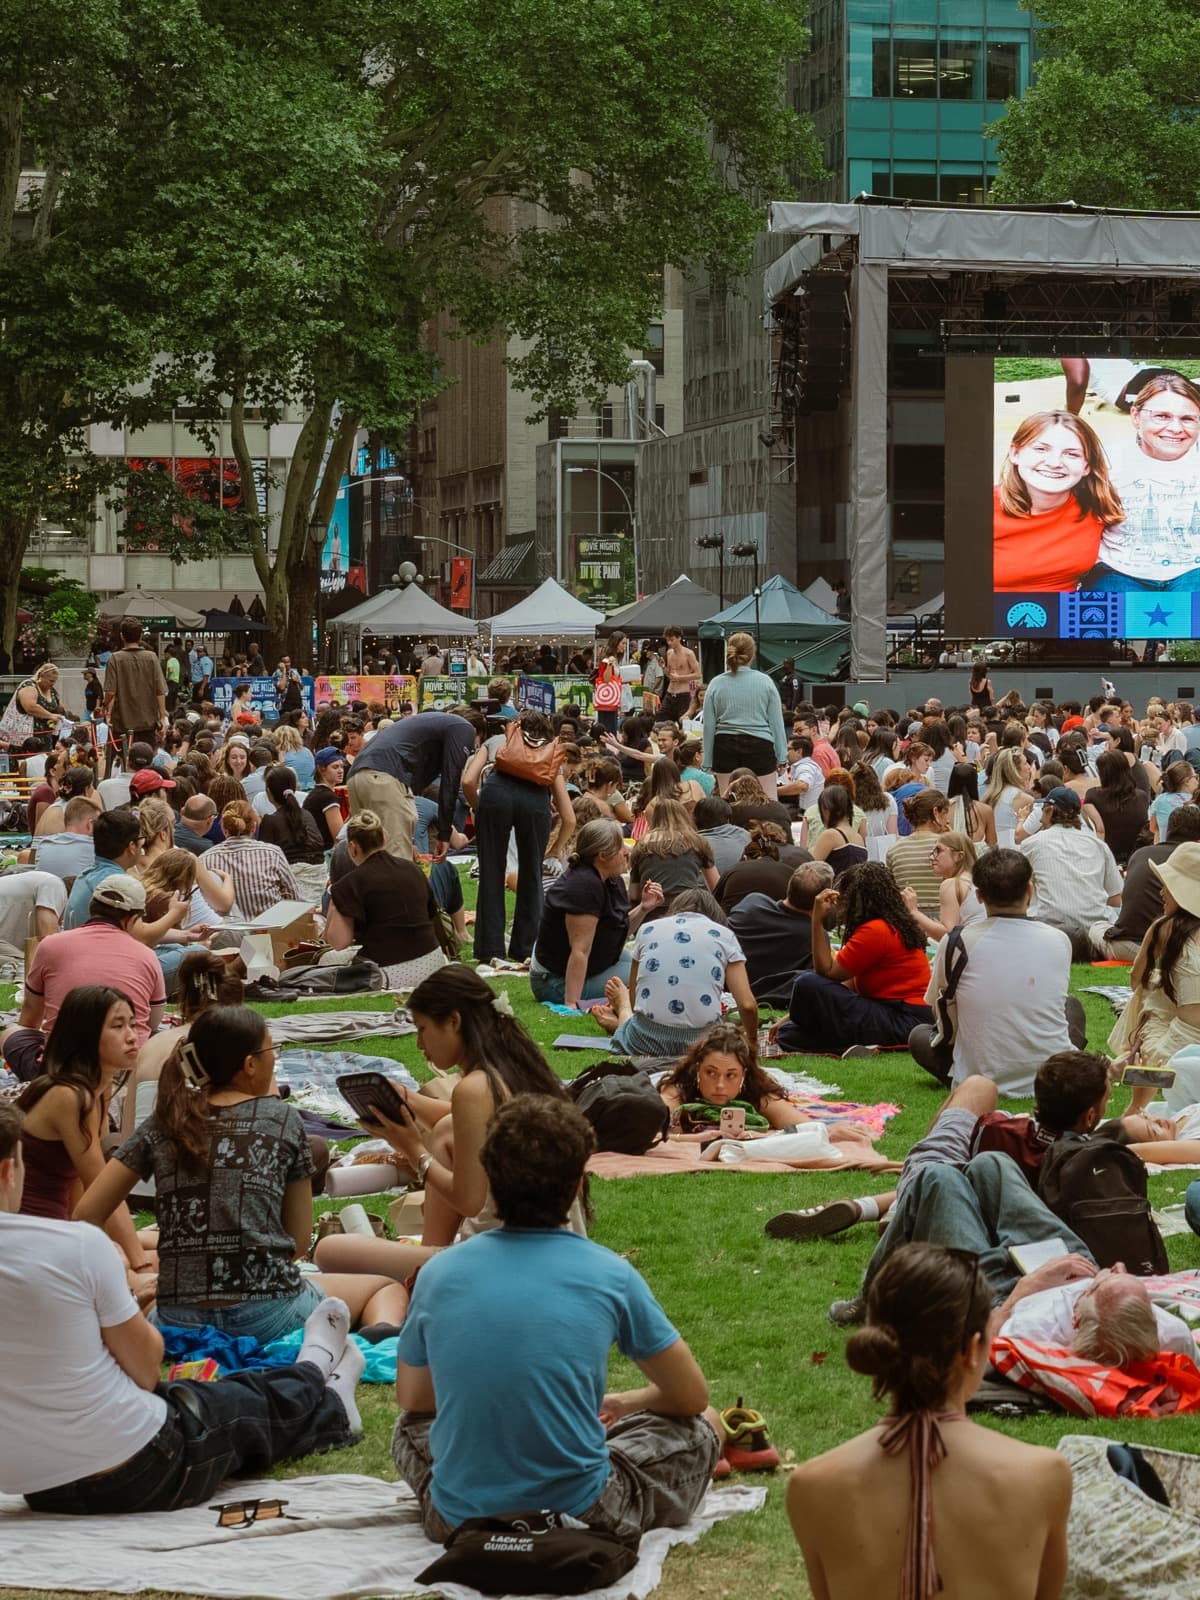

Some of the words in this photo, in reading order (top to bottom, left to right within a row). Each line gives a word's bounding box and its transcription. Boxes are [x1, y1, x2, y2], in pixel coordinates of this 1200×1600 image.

[600, 542, 621, 552] NIGHTS
[603, 566, 621, 579] PARK
[424, 682, 443, 692] MOVIE
[444, 681, 466, 693] NIGHS
[483, 1542, 534, 1551] GUIDANCE
